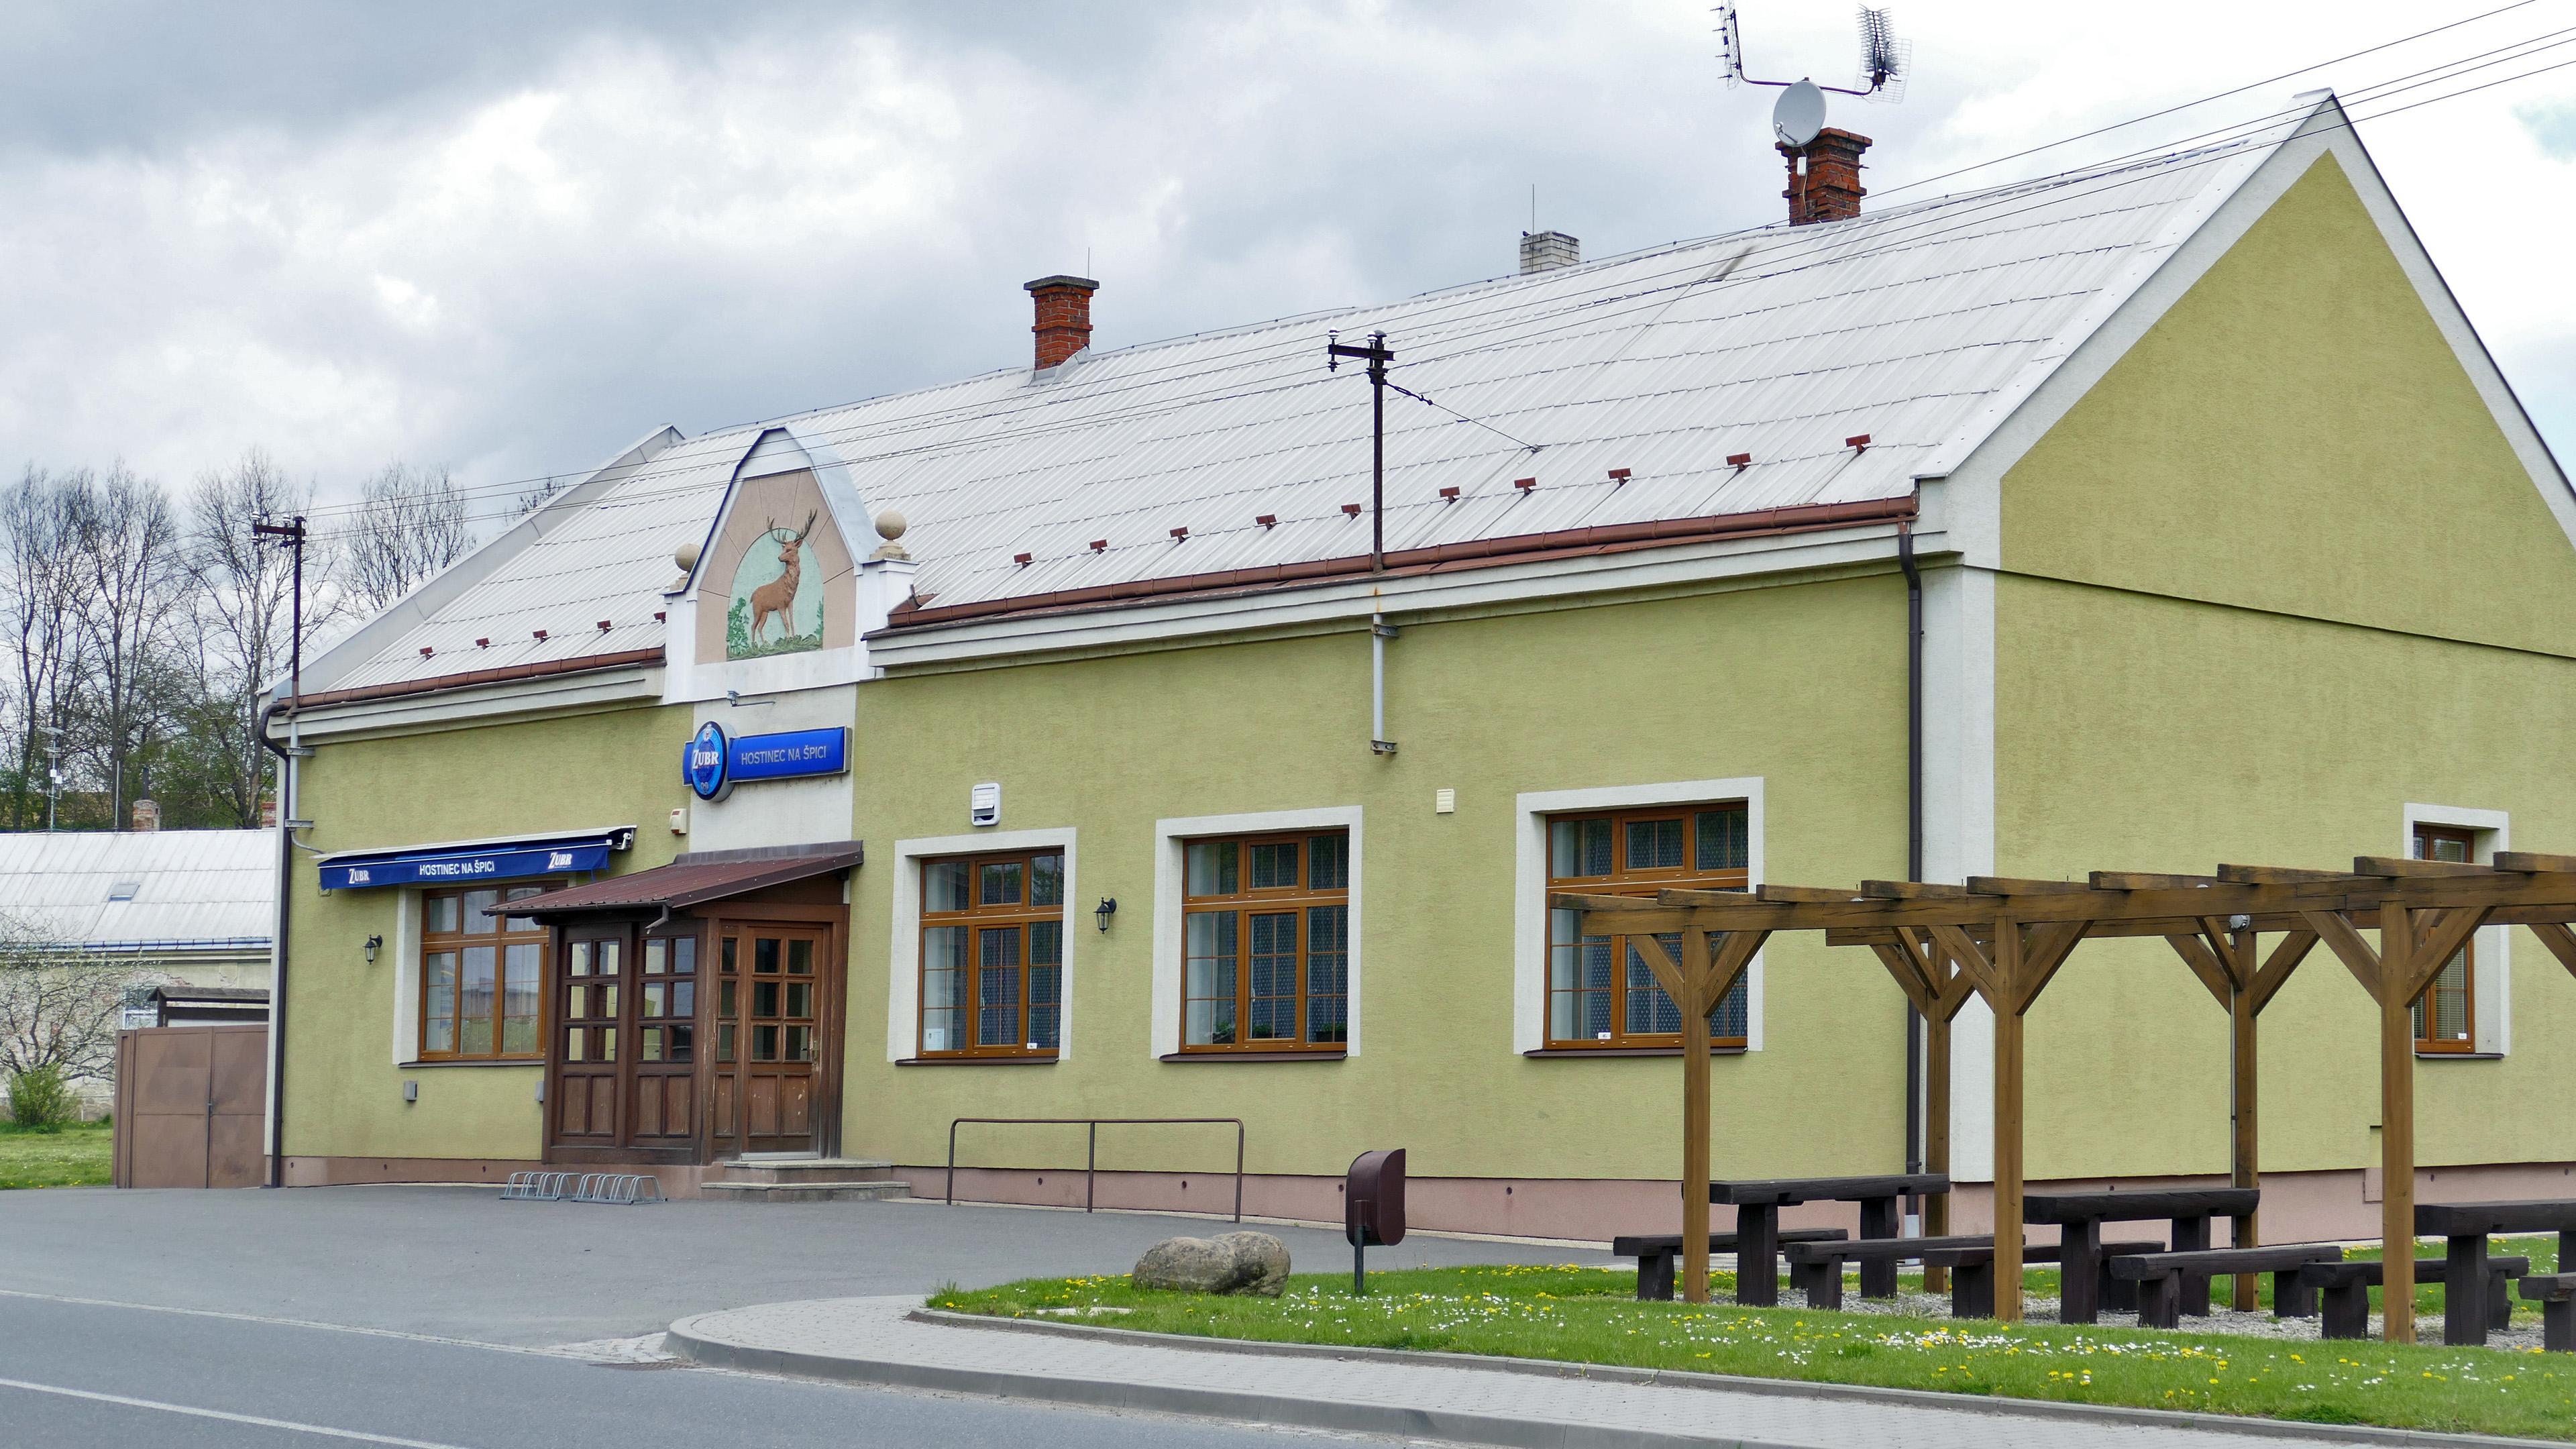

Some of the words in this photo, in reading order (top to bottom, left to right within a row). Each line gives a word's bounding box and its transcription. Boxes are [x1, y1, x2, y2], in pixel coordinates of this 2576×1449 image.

[692, 749, 720, 769] ZUBR
[741, 749, 786, 765] HOSTINEC
[788, 748, 801, 761] NA
[803, 745, 826, 760] ŠPICI
[419, 863, 460, 875] HOSTINEC
[462, 863, 474, 874] NA
[474, 859, 495, 873] ŠPICI
[547, 852, 573, 869] ZUBR
[348, 868, 370, 884] ZUBR
